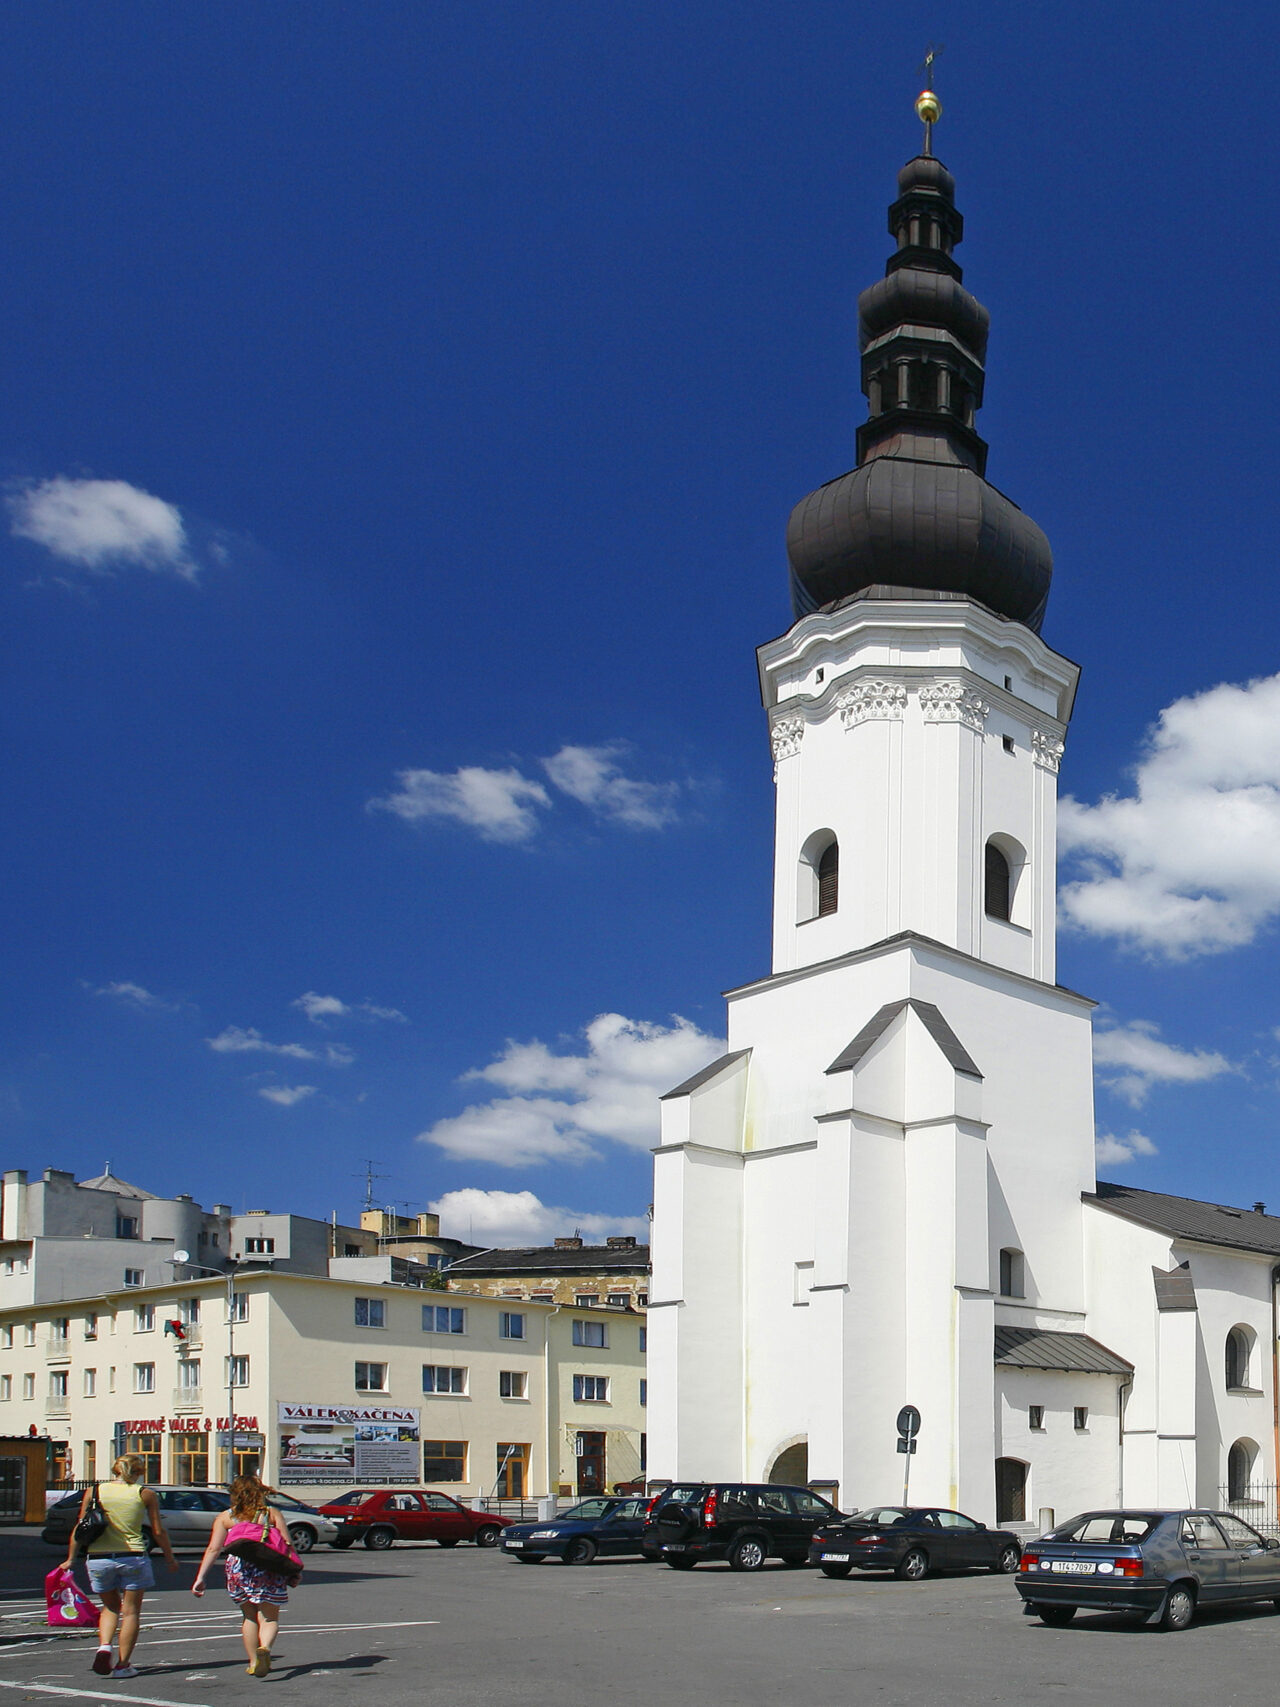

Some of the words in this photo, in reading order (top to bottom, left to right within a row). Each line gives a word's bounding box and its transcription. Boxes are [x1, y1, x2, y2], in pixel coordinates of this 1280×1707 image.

[285, 1405, 337, 1418] VÁLEK
[335, 1410, 354, 1424] &
[349, 1408, 415, 1421] KAČENA
[124, 1416, 166, 1433] UCHYNĚ
[168, 1416, 200, 1432] VÁLEK
[204, 1418, 212, 1431] &
[1058, 1562, 1070, 1571] 1T4
[1075, 1563, 1093, 1572] 7097
